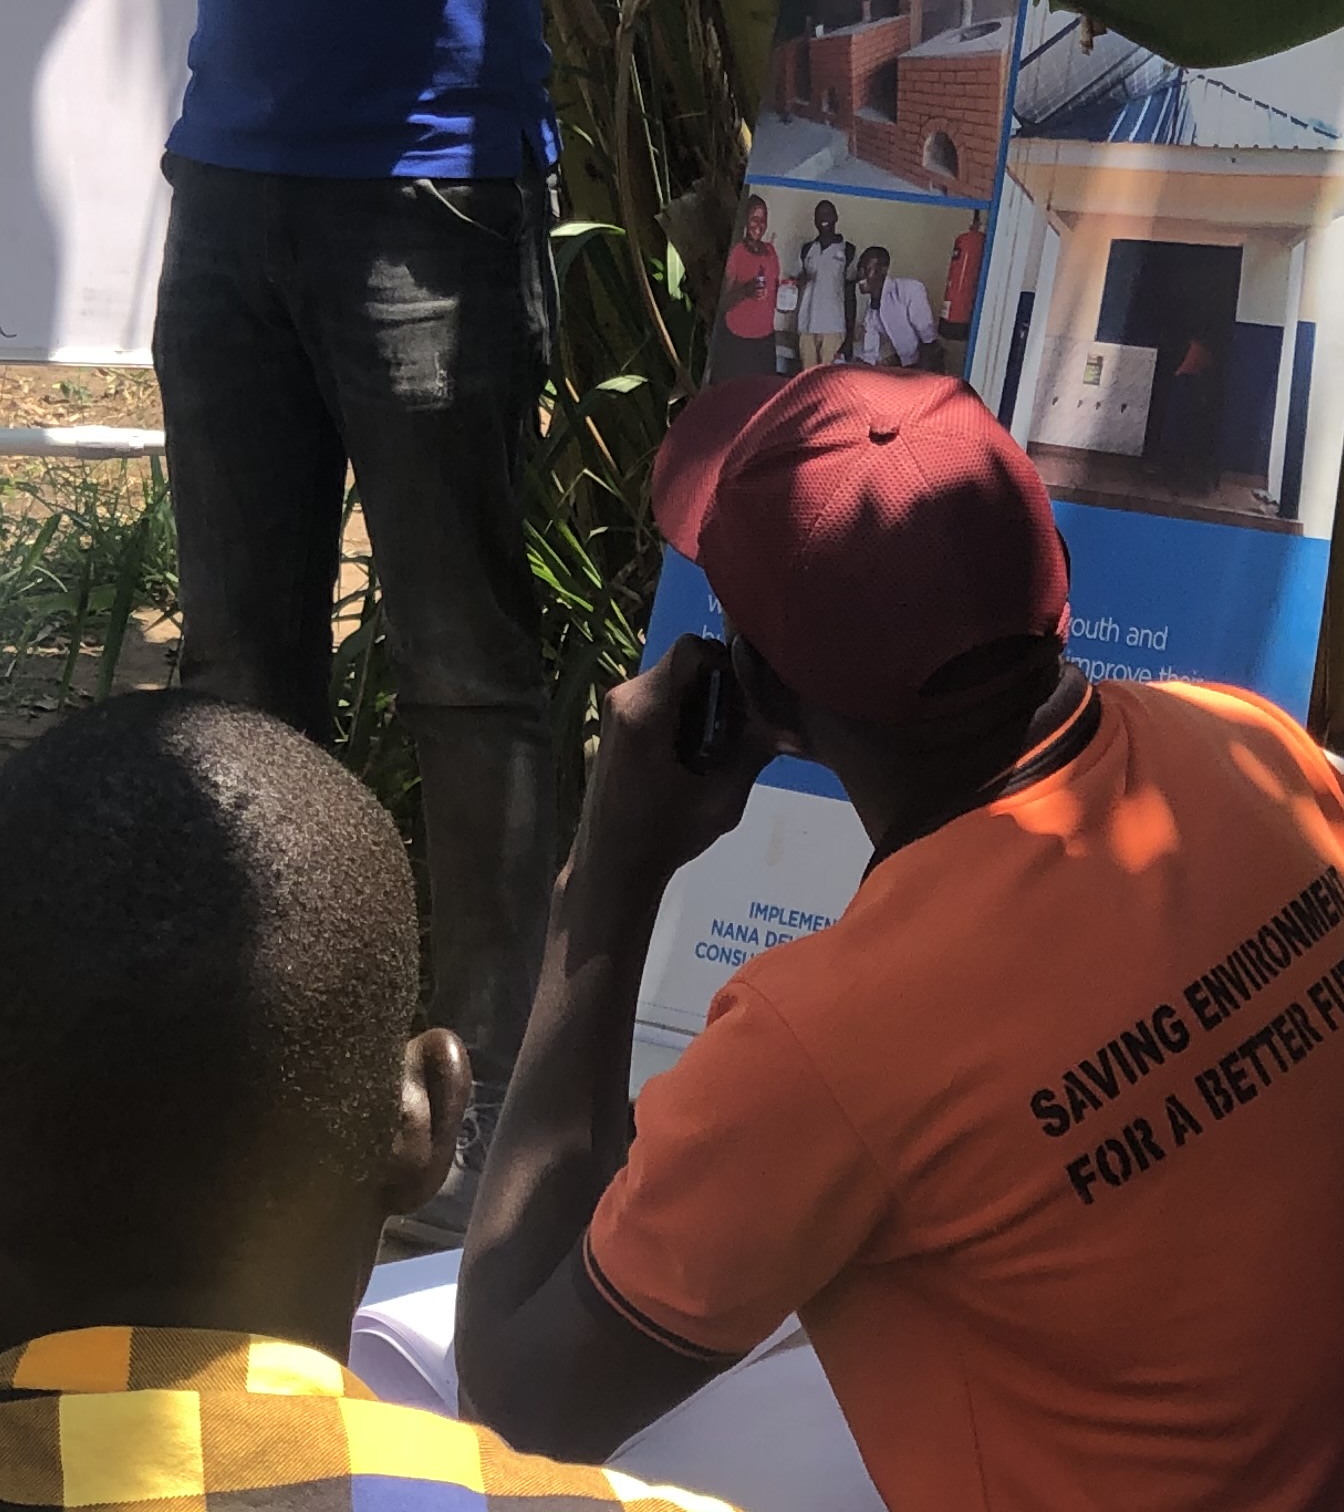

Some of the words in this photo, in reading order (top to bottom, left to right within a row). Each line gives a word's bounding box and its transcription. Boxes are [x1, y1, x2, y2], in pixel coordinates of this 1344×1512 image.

[1068, 616, 1119, 643] outh
[1126, 626, 1169, 651] and
[711, 919, 759, 946] NANA
[1029, 1003, 1191, 1138] SAVING
[1064, 1117, 1166, 1205] FOR
[1165, 1094, 1203, 1148] A
[1194, 1001, 1324, 1121] BETTER
